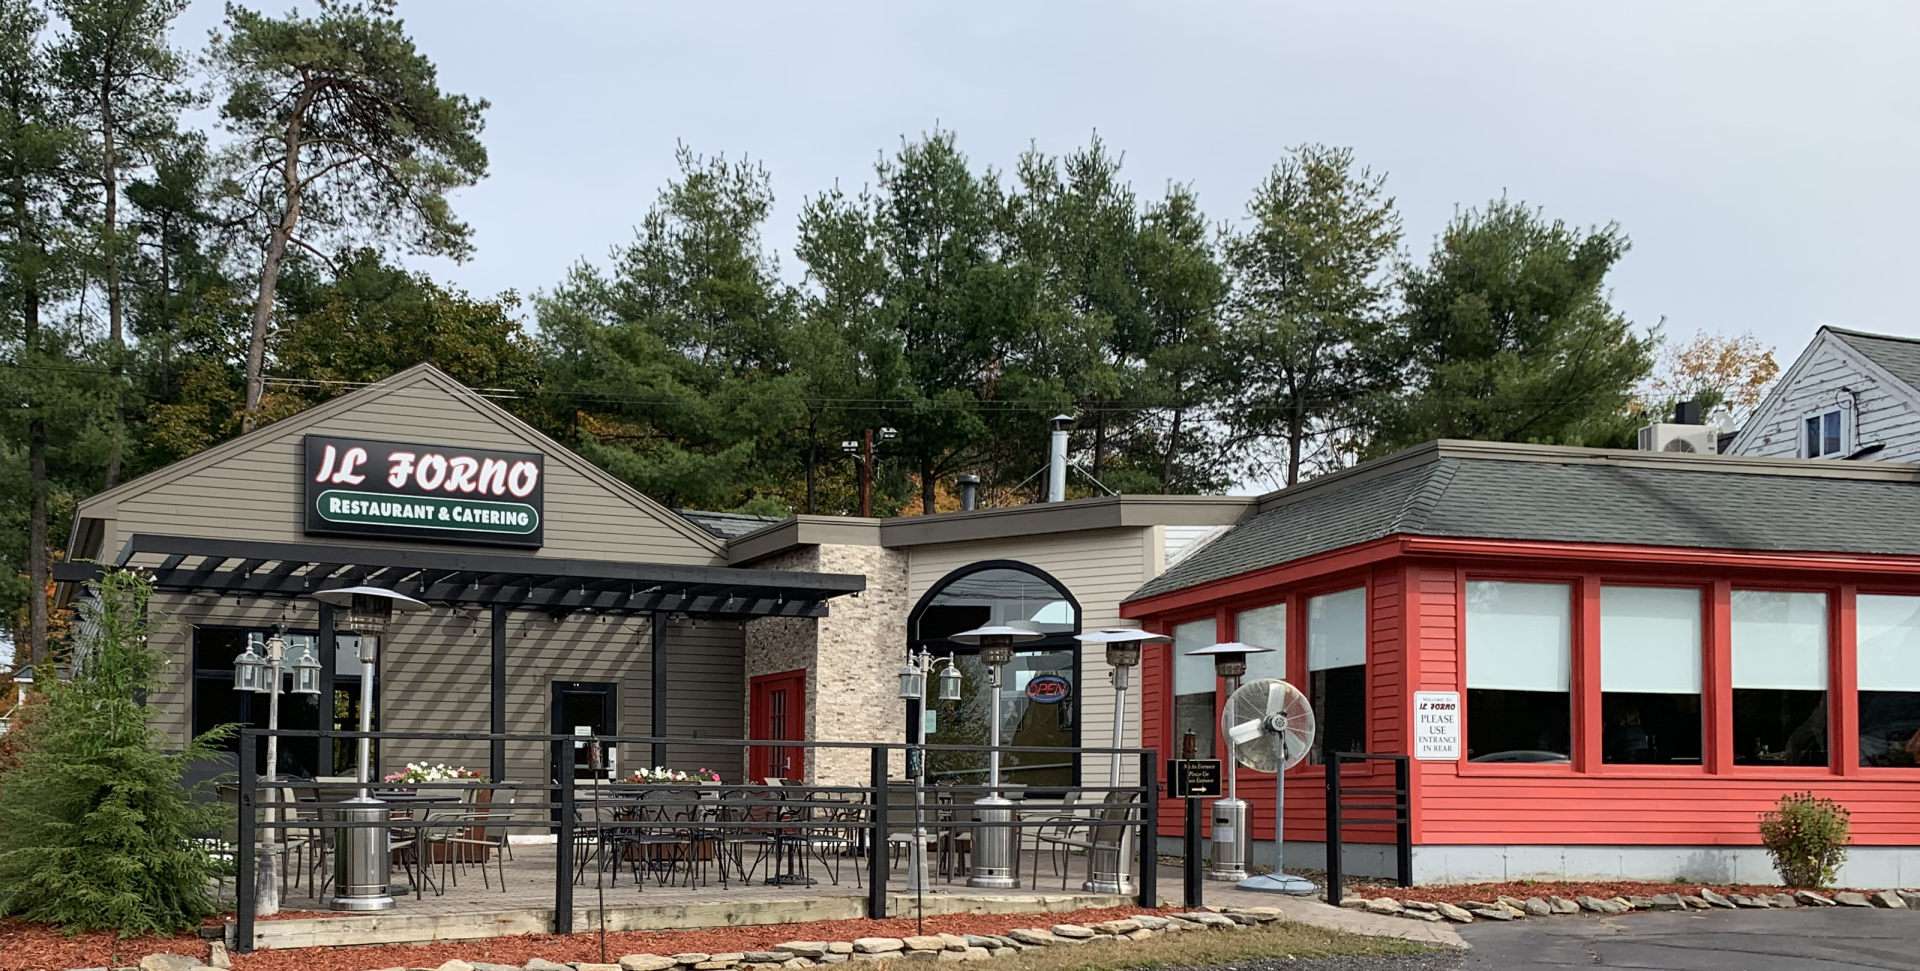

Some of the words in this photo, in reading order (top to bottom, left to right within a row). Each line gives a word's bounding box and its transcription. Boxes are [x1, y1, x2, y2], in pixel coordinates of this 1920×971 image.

[315, 444, 368, 486] IL
[387, 451, 539, 498] FORNO
[330, 497, 435, 520] RESTAURANT
[438, 506, 451, 521] &
[452, 506, 529, 526] CATERING
[1028, 683, 1066, 697] OPEN
[1421, 714, 1454, 723] PLEASE
[1429, 726, 1446, 734] USE
